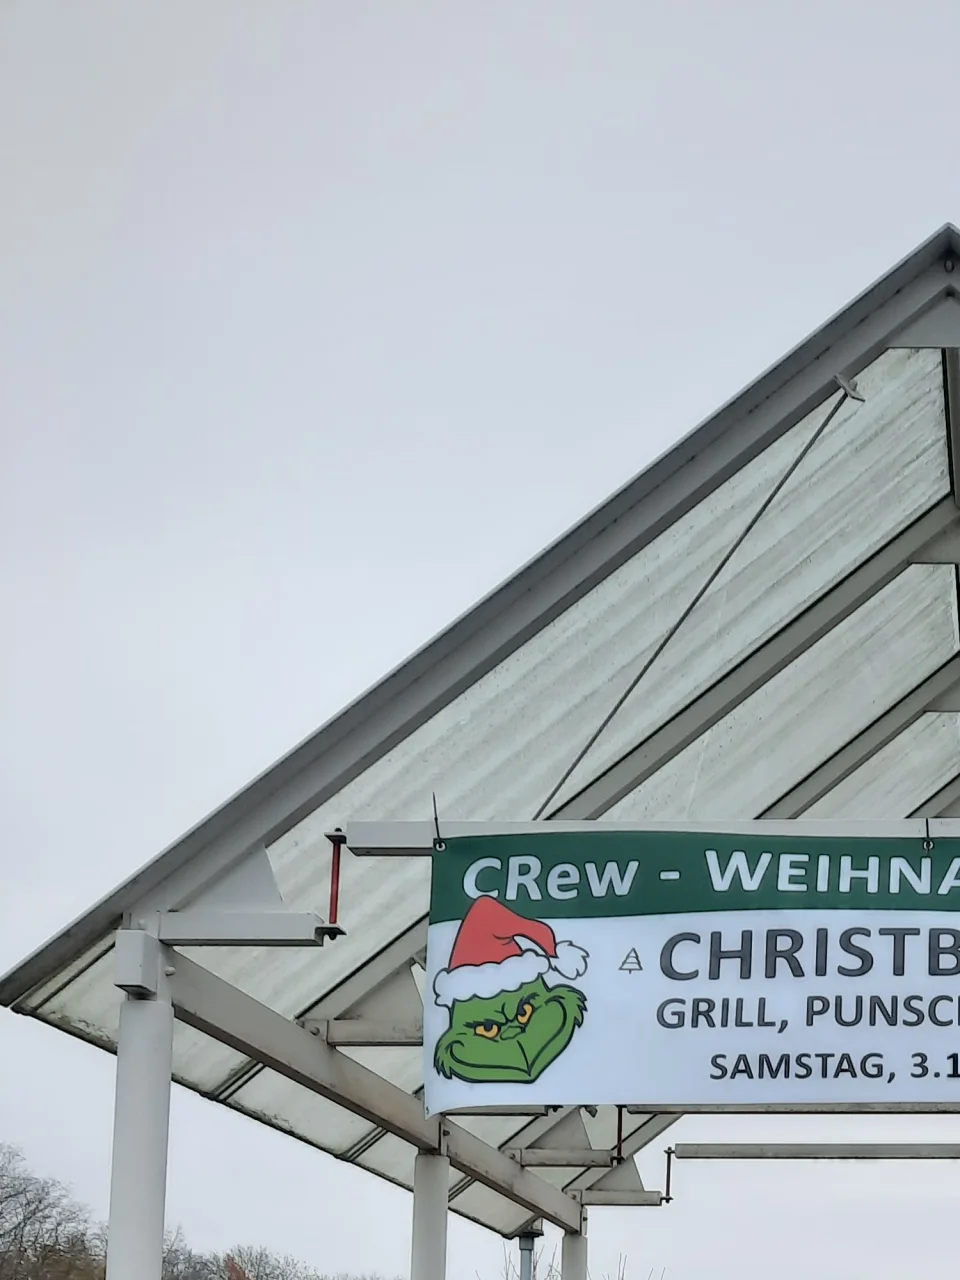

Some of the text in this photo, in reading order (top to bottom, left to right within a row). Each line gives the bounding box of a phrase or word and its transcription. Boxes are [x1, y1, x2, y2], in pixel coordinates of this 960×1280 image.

[463, 855, 640, 900] CRew
[656, 997, 788, 1033] GRILL,
[709, 1052, 896, 1084] SAMSTAG,
